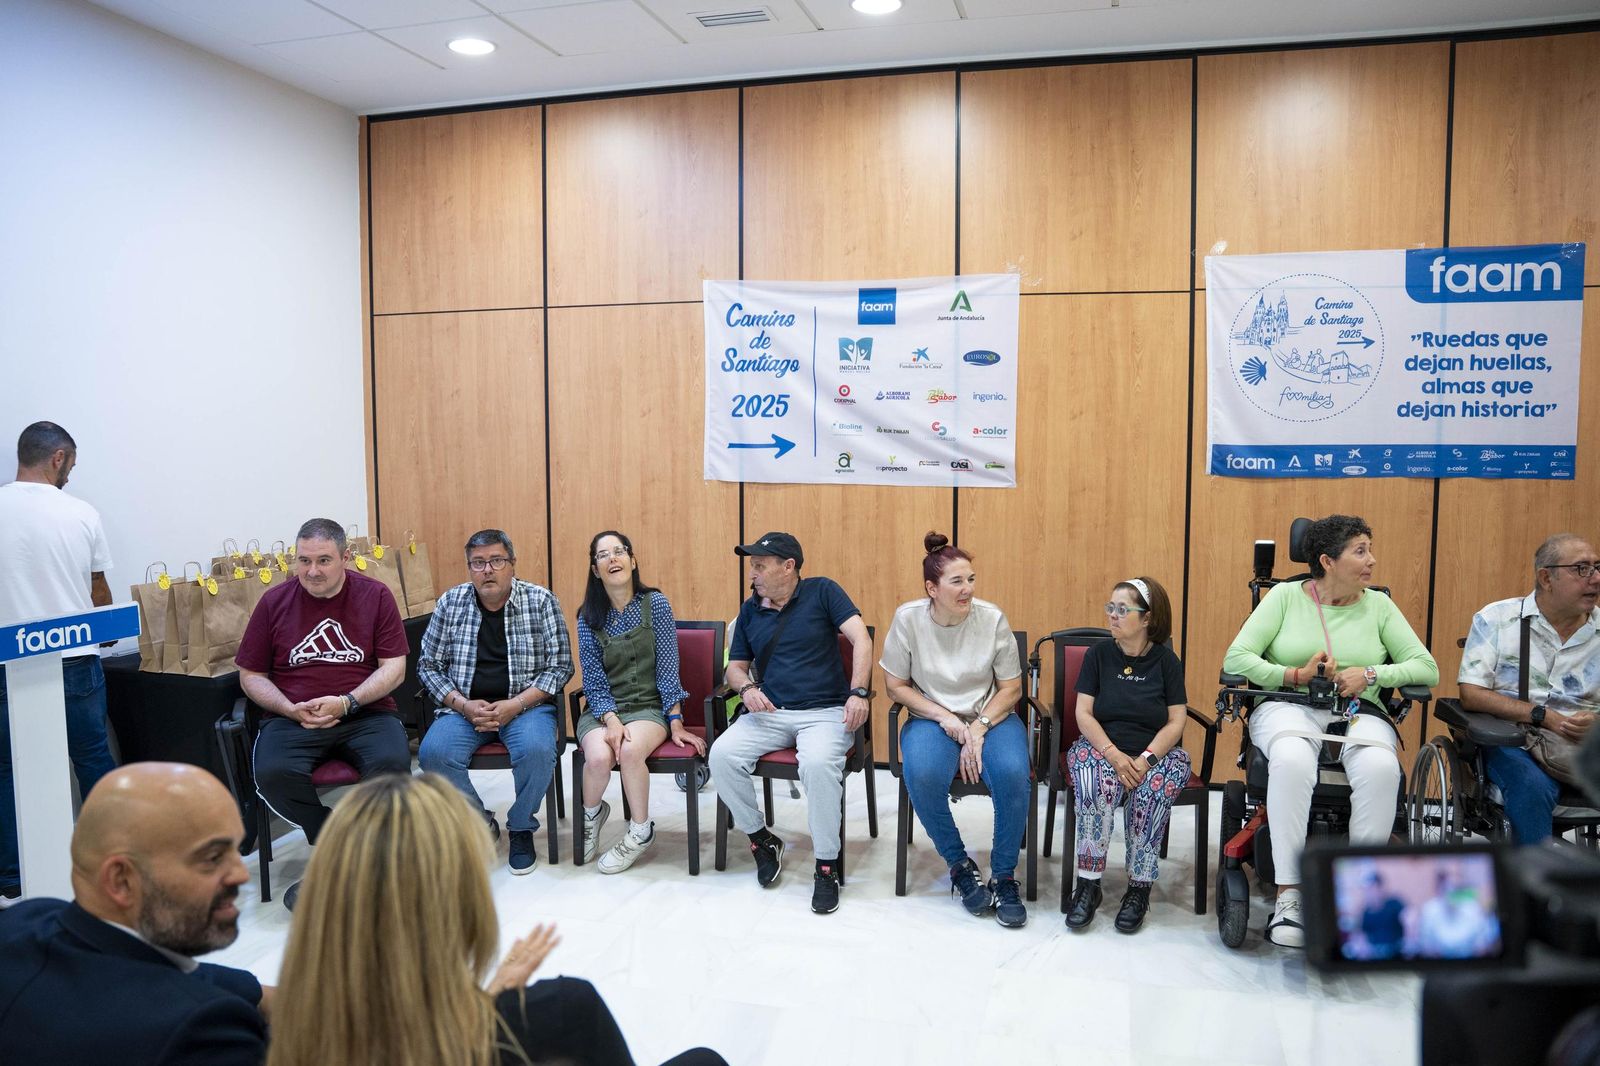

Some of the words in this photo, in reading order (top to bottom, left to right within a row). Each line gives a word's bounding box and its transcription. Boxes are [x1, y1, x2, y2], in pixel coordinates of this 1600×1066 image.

[1429, 255, 1562, 294] faam
[861, 301, 893, 312] faam
[1314, 296, 1354, 310] Camino
[725, 302, 797, 328] Camino
[1303, 315, 1316, 326] de
[1319, 312, 1364, 328] Santiago
[749, 329, 772, 350] de
[1338, 329, 1363, 339] 2025
[1505, 333, 1549, 351] que
[720, 347, 801, 379] Santiago
[1404, 354, 1464, 375] dejan
[1469, 353, 1553, 373] huellas,
[972, 391, 1004, 403] ingenio
[1421, 377, 1486, 398] almas
[1491, 380, 1534, 401] que
[731, 394, 791, 418] 2025
[1396, 400, 1456, 421] dejan
[951, 461, 969, 469] CASI
[1226, 453, 1276, 470] faam
[15, 622, 93, 655] faam
